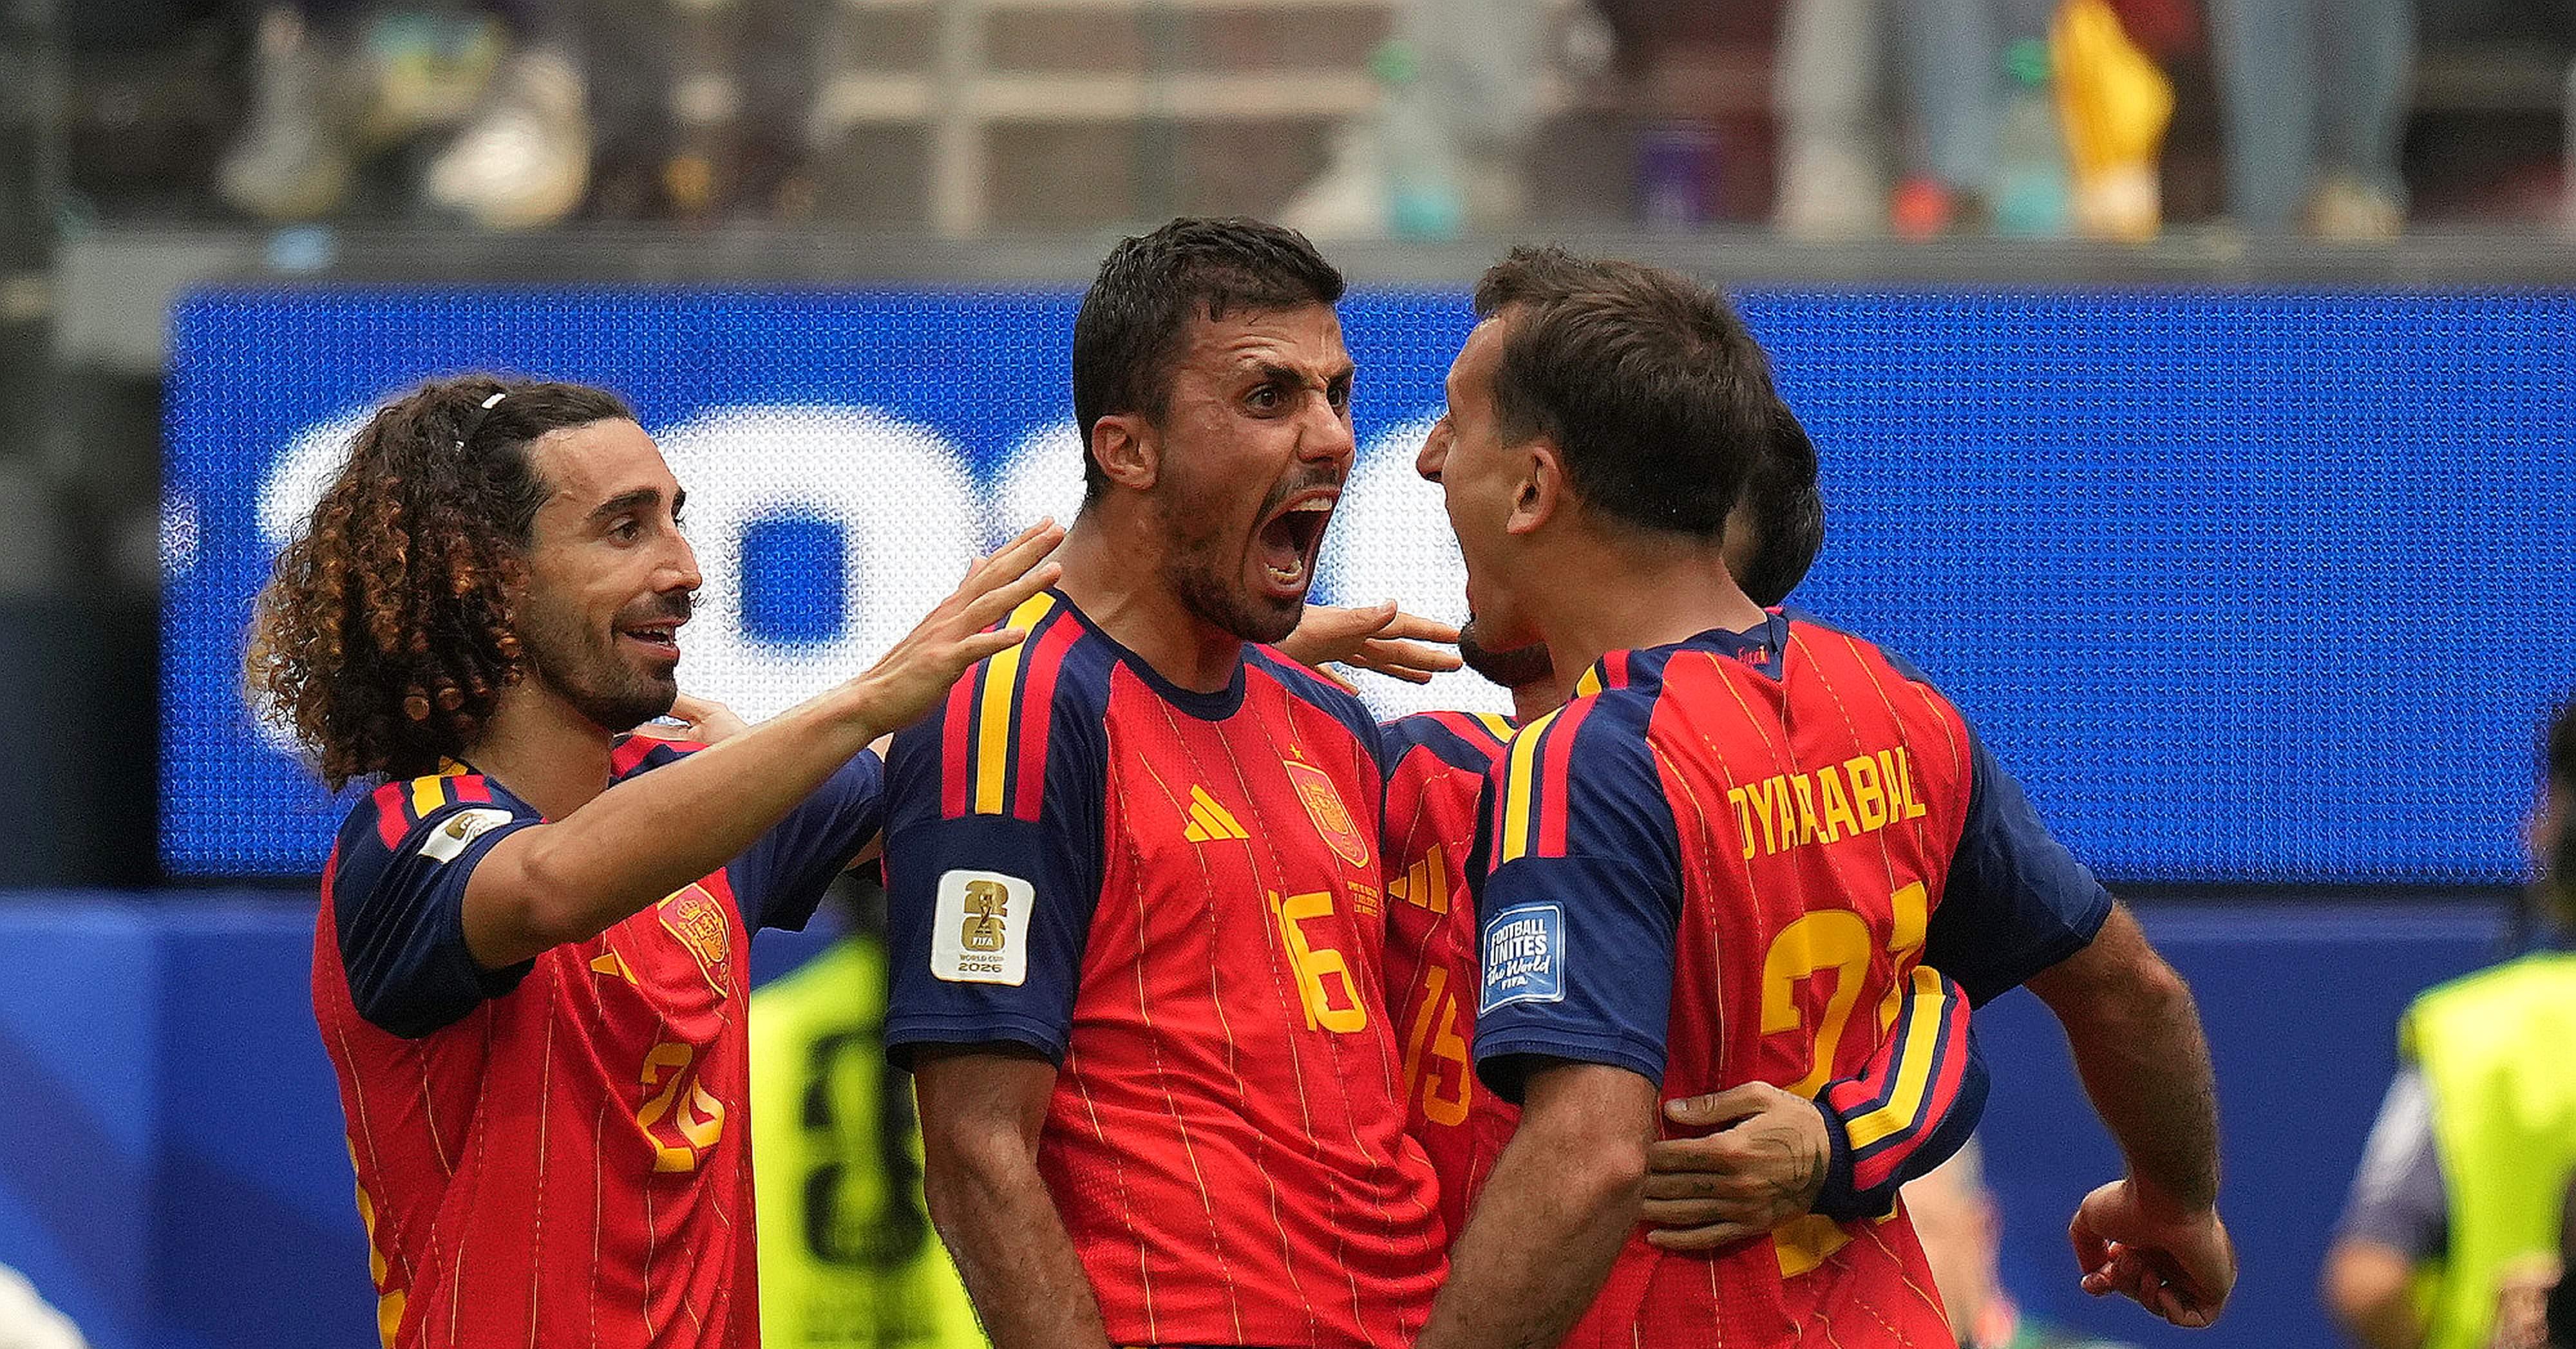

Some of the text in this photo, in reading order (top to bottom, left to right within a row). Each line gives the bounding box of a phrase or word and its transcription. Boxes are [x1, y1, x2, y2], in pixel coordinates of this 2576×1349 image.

[972, 937, 994, 946] FIFA
[1492, 919, 1547, 945] FOOTBALL
[1269, 889, 1367, 1034] 16
[1490, 935, 1548, 967] UNITES
[958, 963, 1003, 972] 2026
[1487, 955, 1551, 986] the World
[1501, 976, 1528, 990] FIFA
[1405, 965, 1472, 1126] 15
